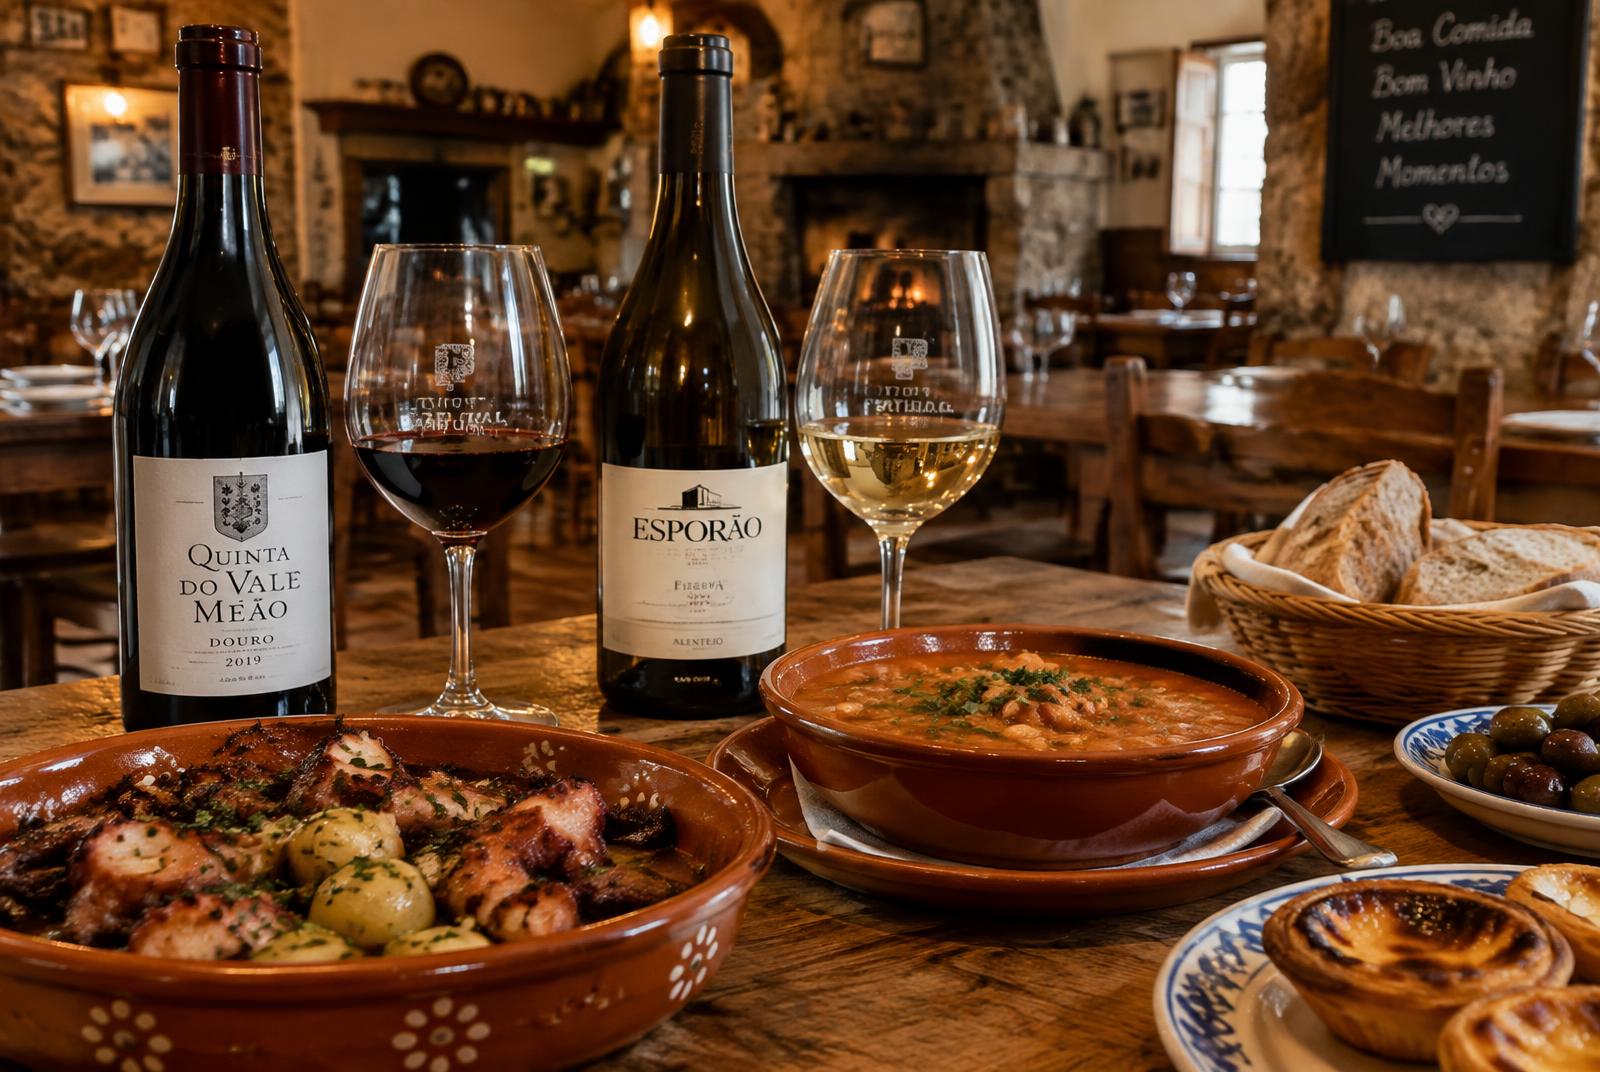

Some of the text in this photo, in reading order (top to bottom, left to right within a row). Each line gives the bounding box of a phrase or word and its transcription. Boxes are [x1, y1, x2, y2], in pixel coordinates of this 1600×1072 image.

[1432, 9, 1534, 47] Comida
[1372, 57, 1517, 98] Bom Vinho
[1375, 108, 1495, 142] Melhores
[1375, 154, 1509, 188] Momentos
[632, 514, 762, 542] ESPORÃO
[187, 543, 290, 572] QUINTA
[179, 570, 301, 596] DO VALE
[209, 635, 274, 647] DOURO
[672, 637, 724, 646] ALENTEJO
[225, 655, 261, 667] 2019
